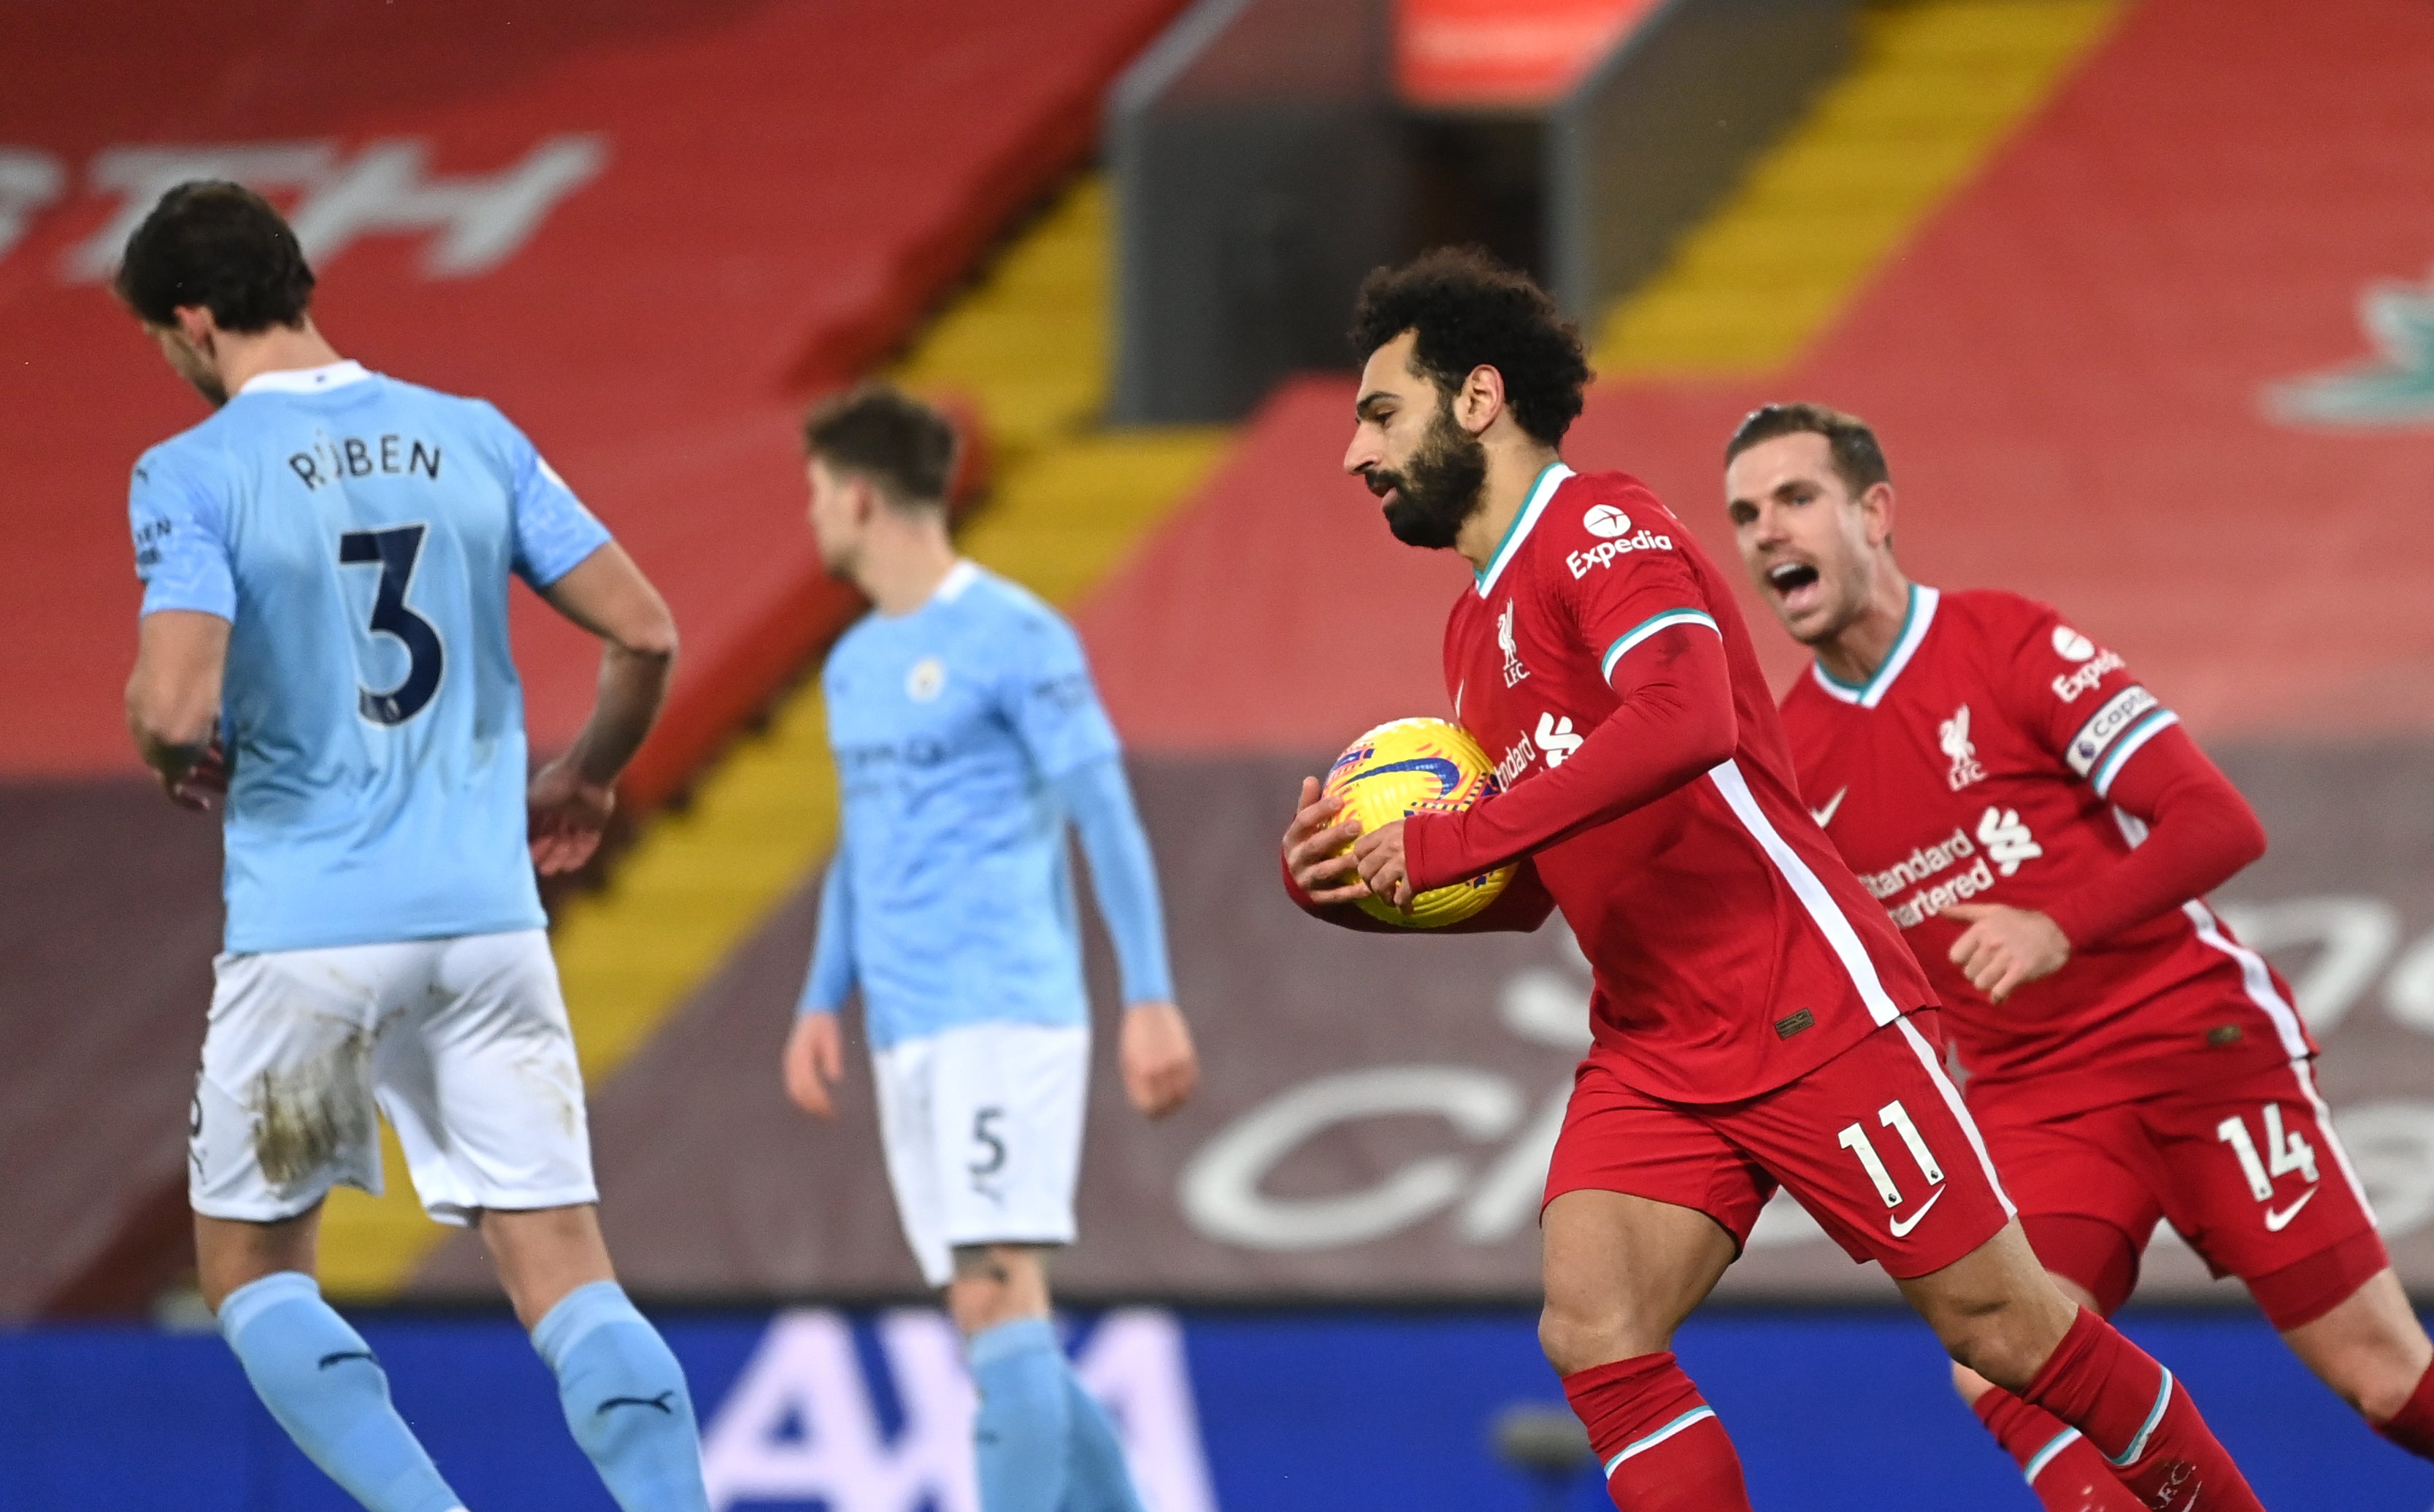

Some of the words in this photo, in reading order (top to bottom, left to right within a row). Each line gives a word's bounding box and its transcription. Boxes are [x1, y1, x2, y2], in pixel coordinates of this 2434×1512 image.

[1565, 529, 1673, 580] Expedia
[339, 523, 444, 726] 3
[967, 1105, 1008, 1175] 5
[1837, 1099, 1946, 1208] 11
[2216, 1102, 2320, 1202] 14
